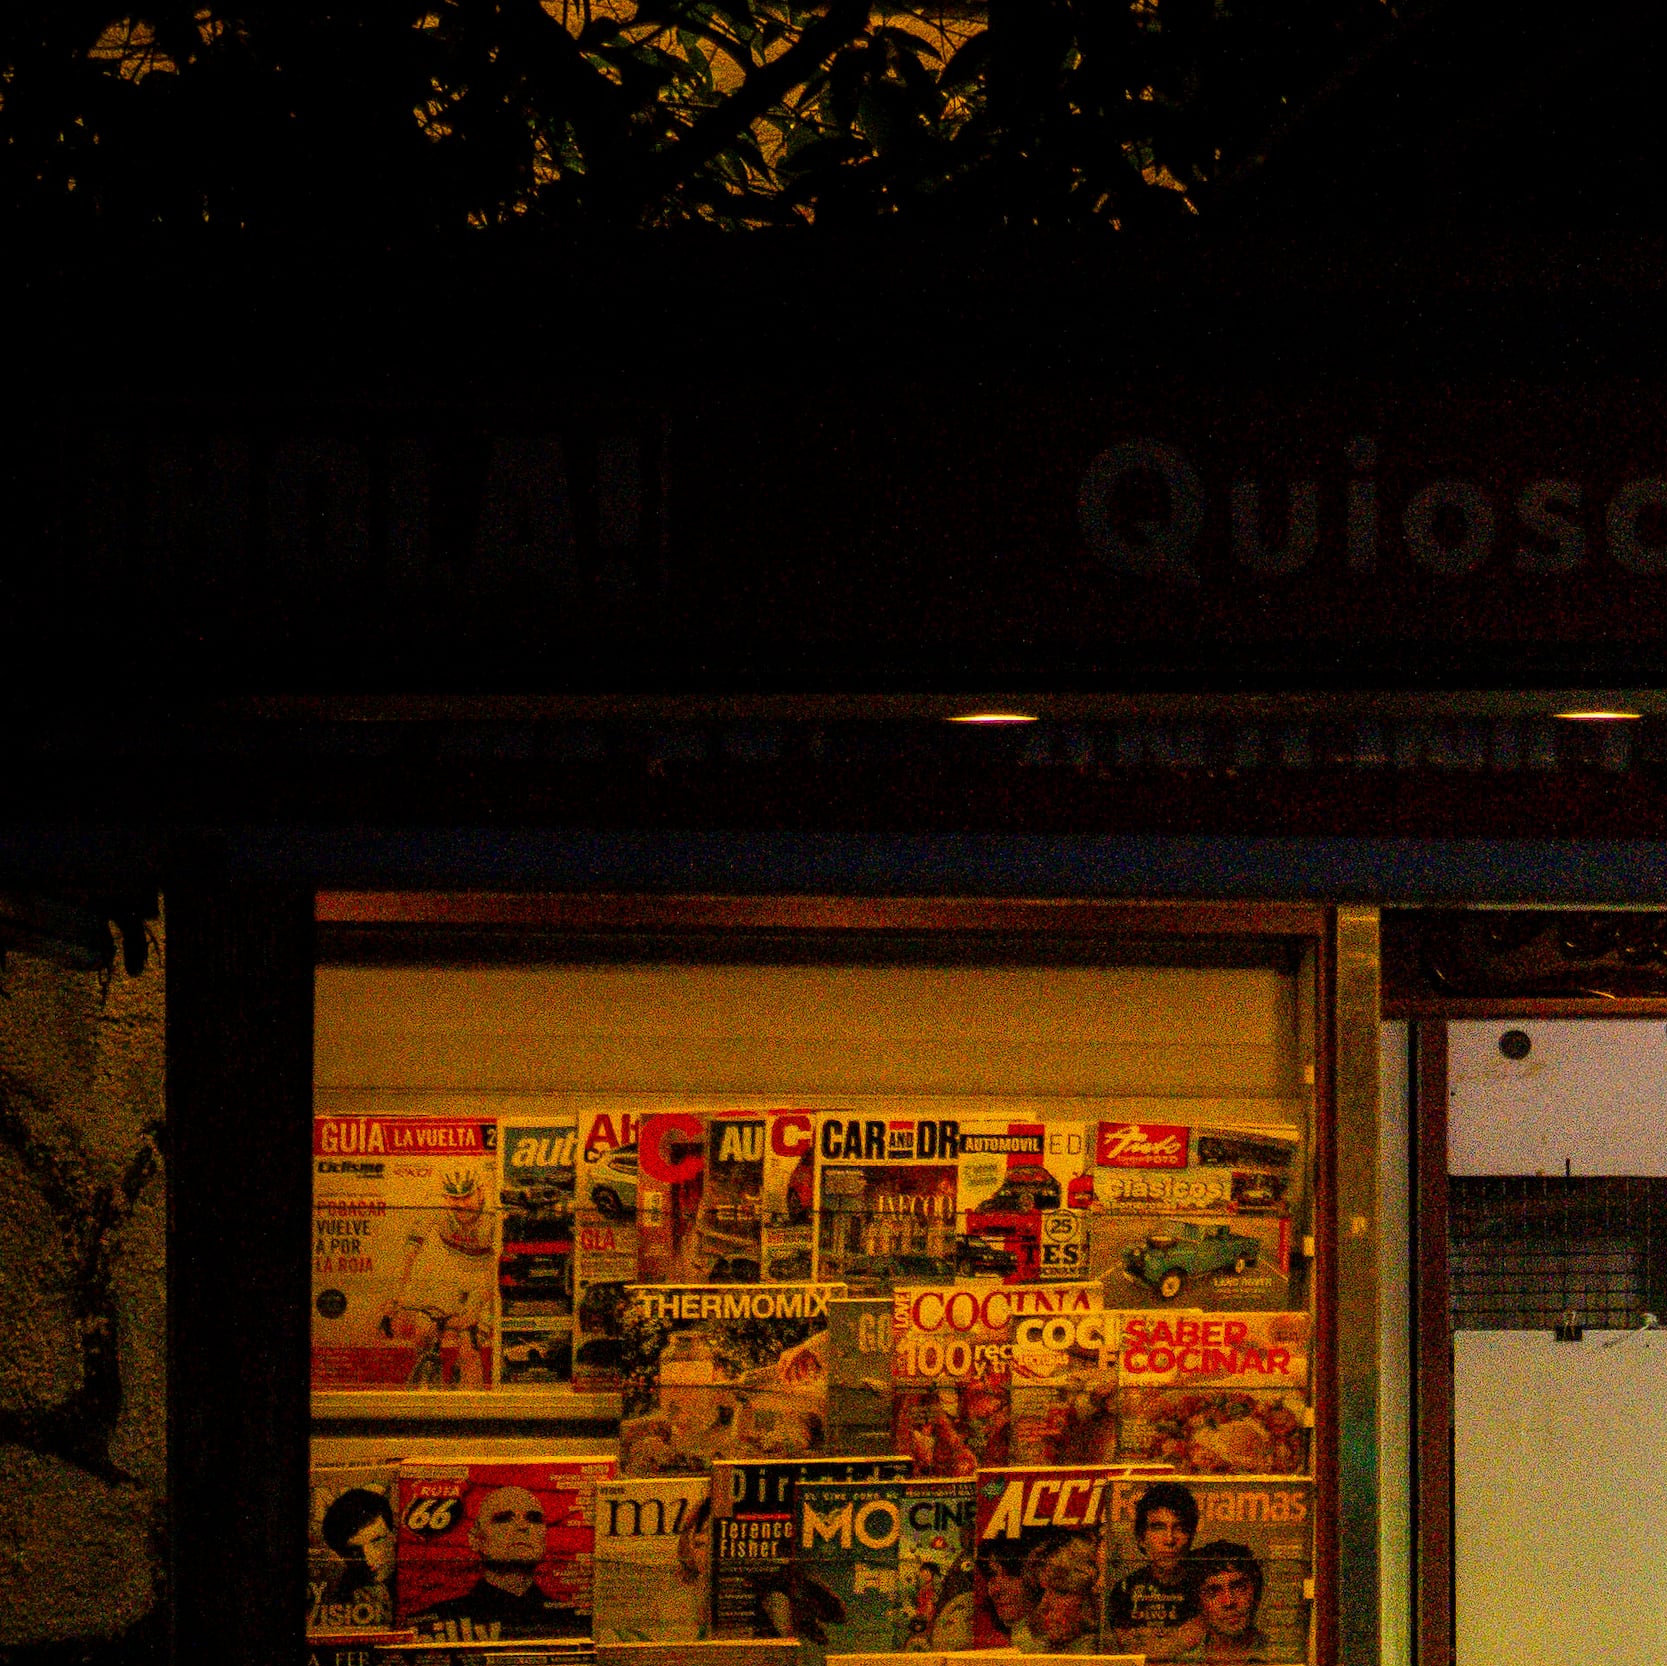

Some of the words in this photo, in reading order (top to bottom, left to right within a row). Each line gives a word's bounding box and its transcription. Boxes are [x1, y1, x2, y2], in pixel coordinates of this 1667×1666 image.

[416, 1128, 477, 1147] VUELTA
[822, 1120, 885, 1160] CAR
[888, 1132, 914, 1149] AND
[317, 1220, 370, 1235] VUELVE
[640, 1292, 829, 1319] THERMOMIX
[1125, 1320, 1247, 1346] SABER
[1124, 1348, 1290, 1374] COCINAR
[720, 1521, 793, 1538] Terence
[720, 1540, 779, 1558] Fisher
